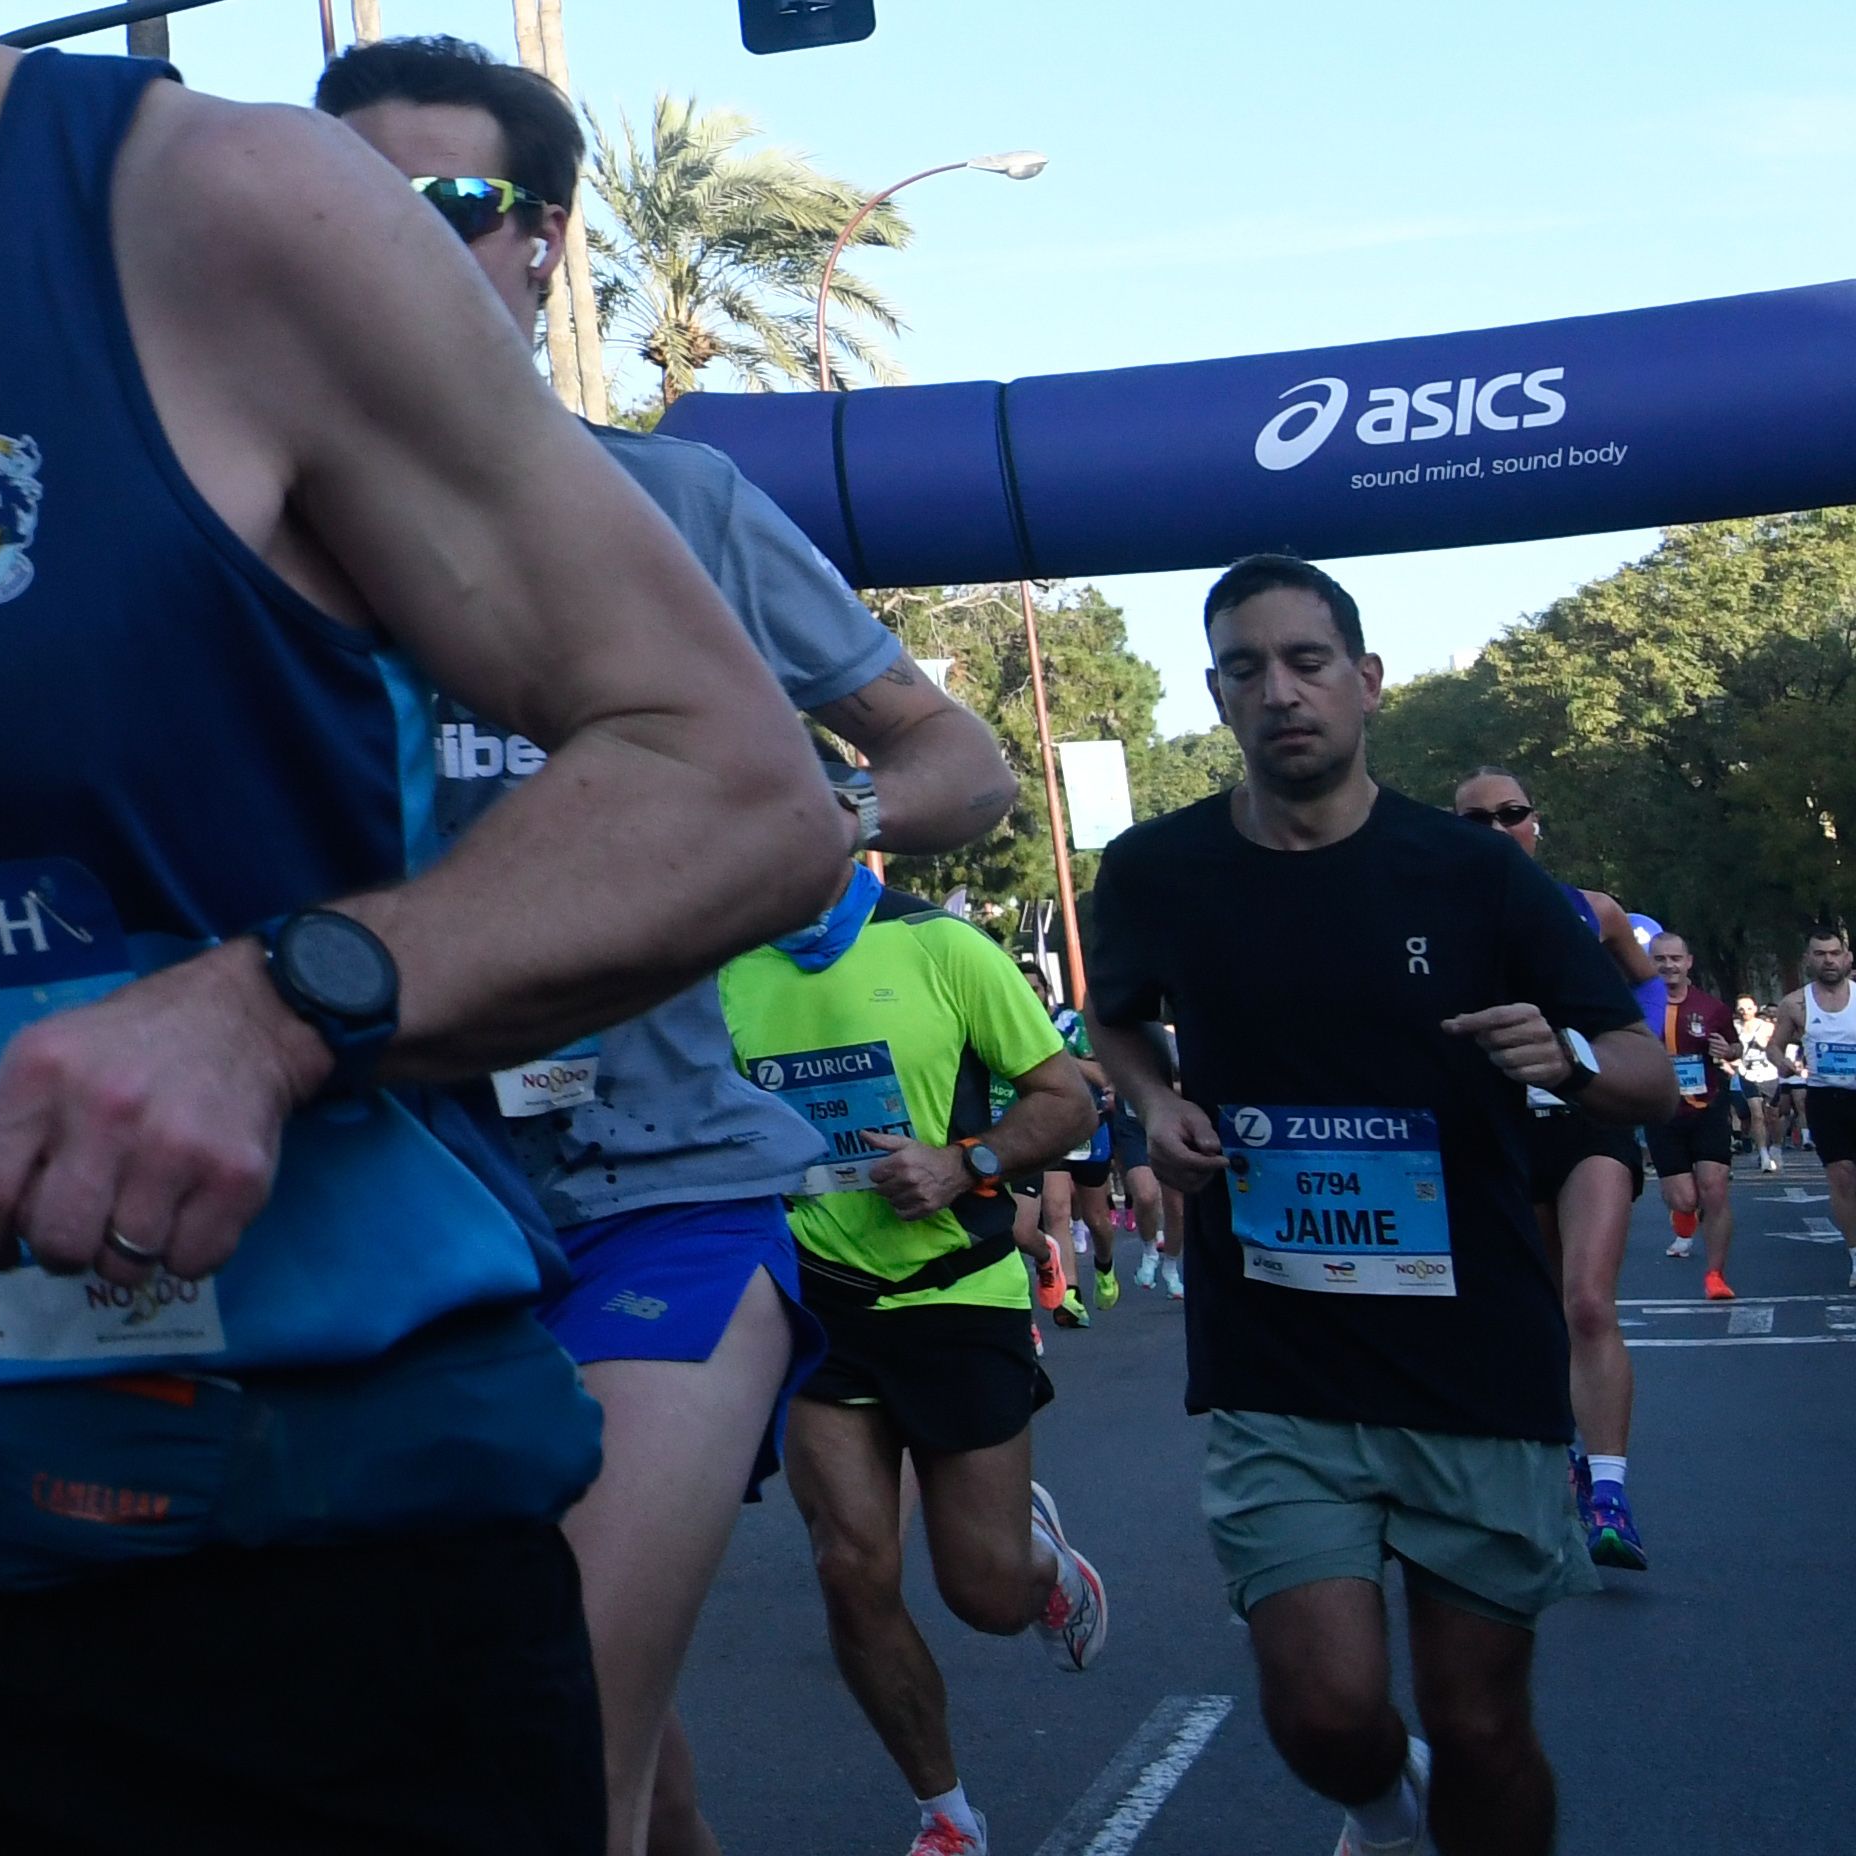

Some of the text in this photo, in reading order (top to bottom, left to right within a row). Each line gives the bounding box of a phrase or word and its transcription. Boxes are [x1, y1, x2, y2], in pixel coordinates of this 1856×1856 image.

[1355, 367, 1566, 445] asics
[1350, 441, 1628, 490] sound mind, sound body
[792, 1053, 873, 1080] ZURICH
[805, 1099, 849, 1121] 7599
[1286, 1117, 1409, 1140] ZURICH
[1296, 1172, 1361, 1195] 6794
[1275, 1208, 1400, 1246] JAIME
